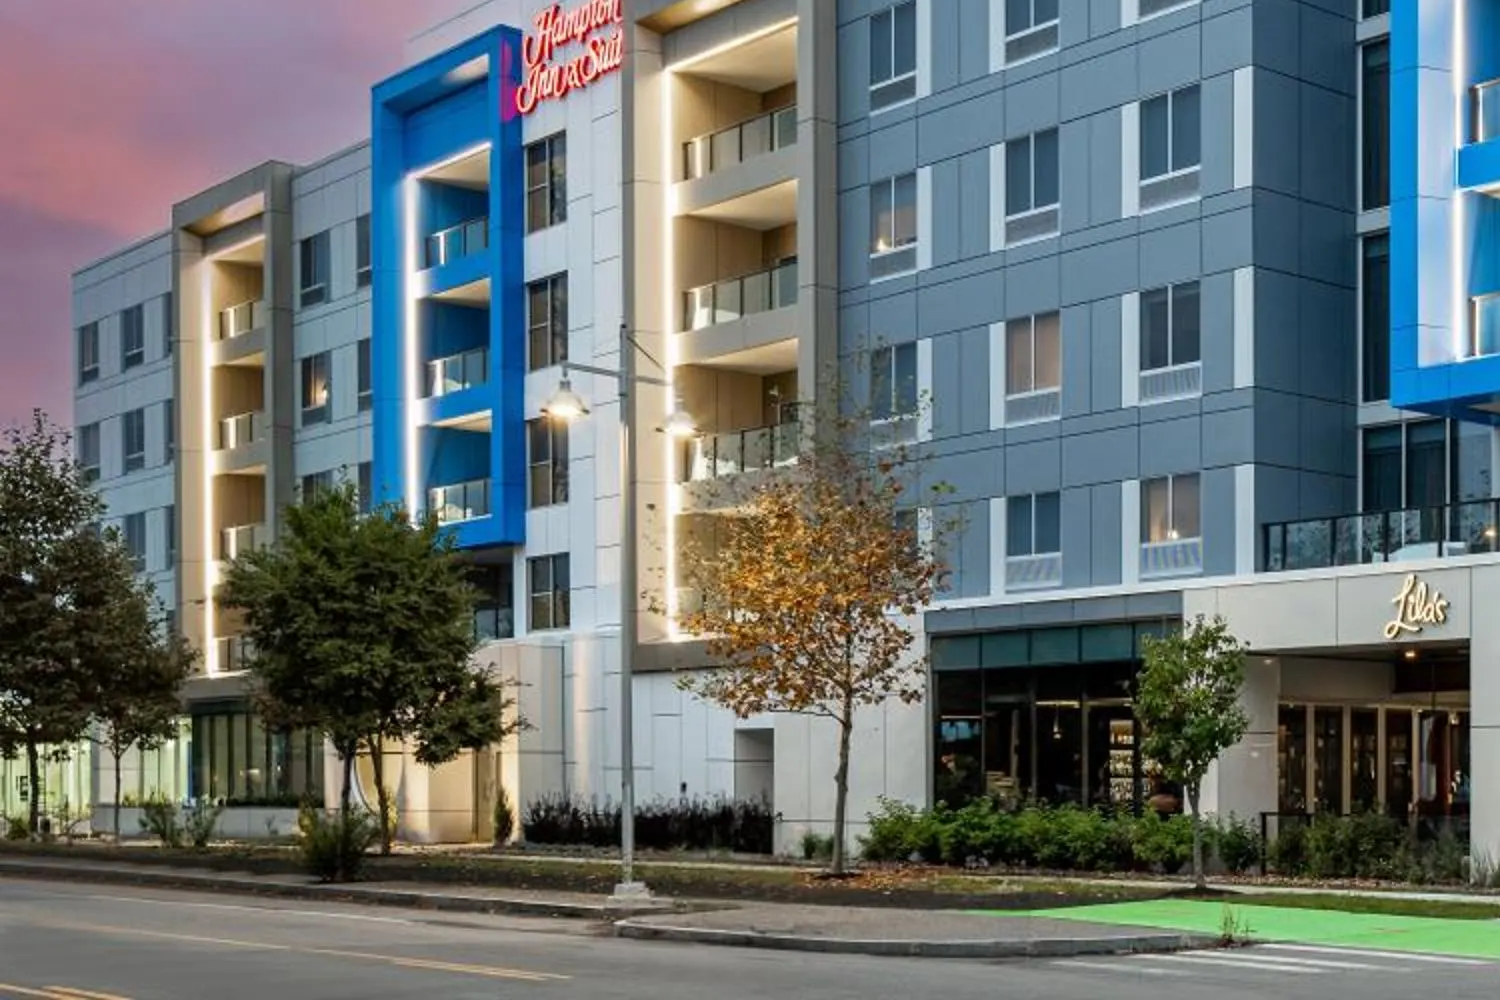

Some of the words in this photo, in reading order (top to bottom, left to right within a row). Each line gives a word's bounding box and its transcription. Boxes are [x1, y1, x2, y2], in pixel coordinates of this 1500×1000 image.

[516, 63, 568, 113] Inn
[580, 29, 623, 81] Suit
[1384, 572, 1449, 638] Lila's
